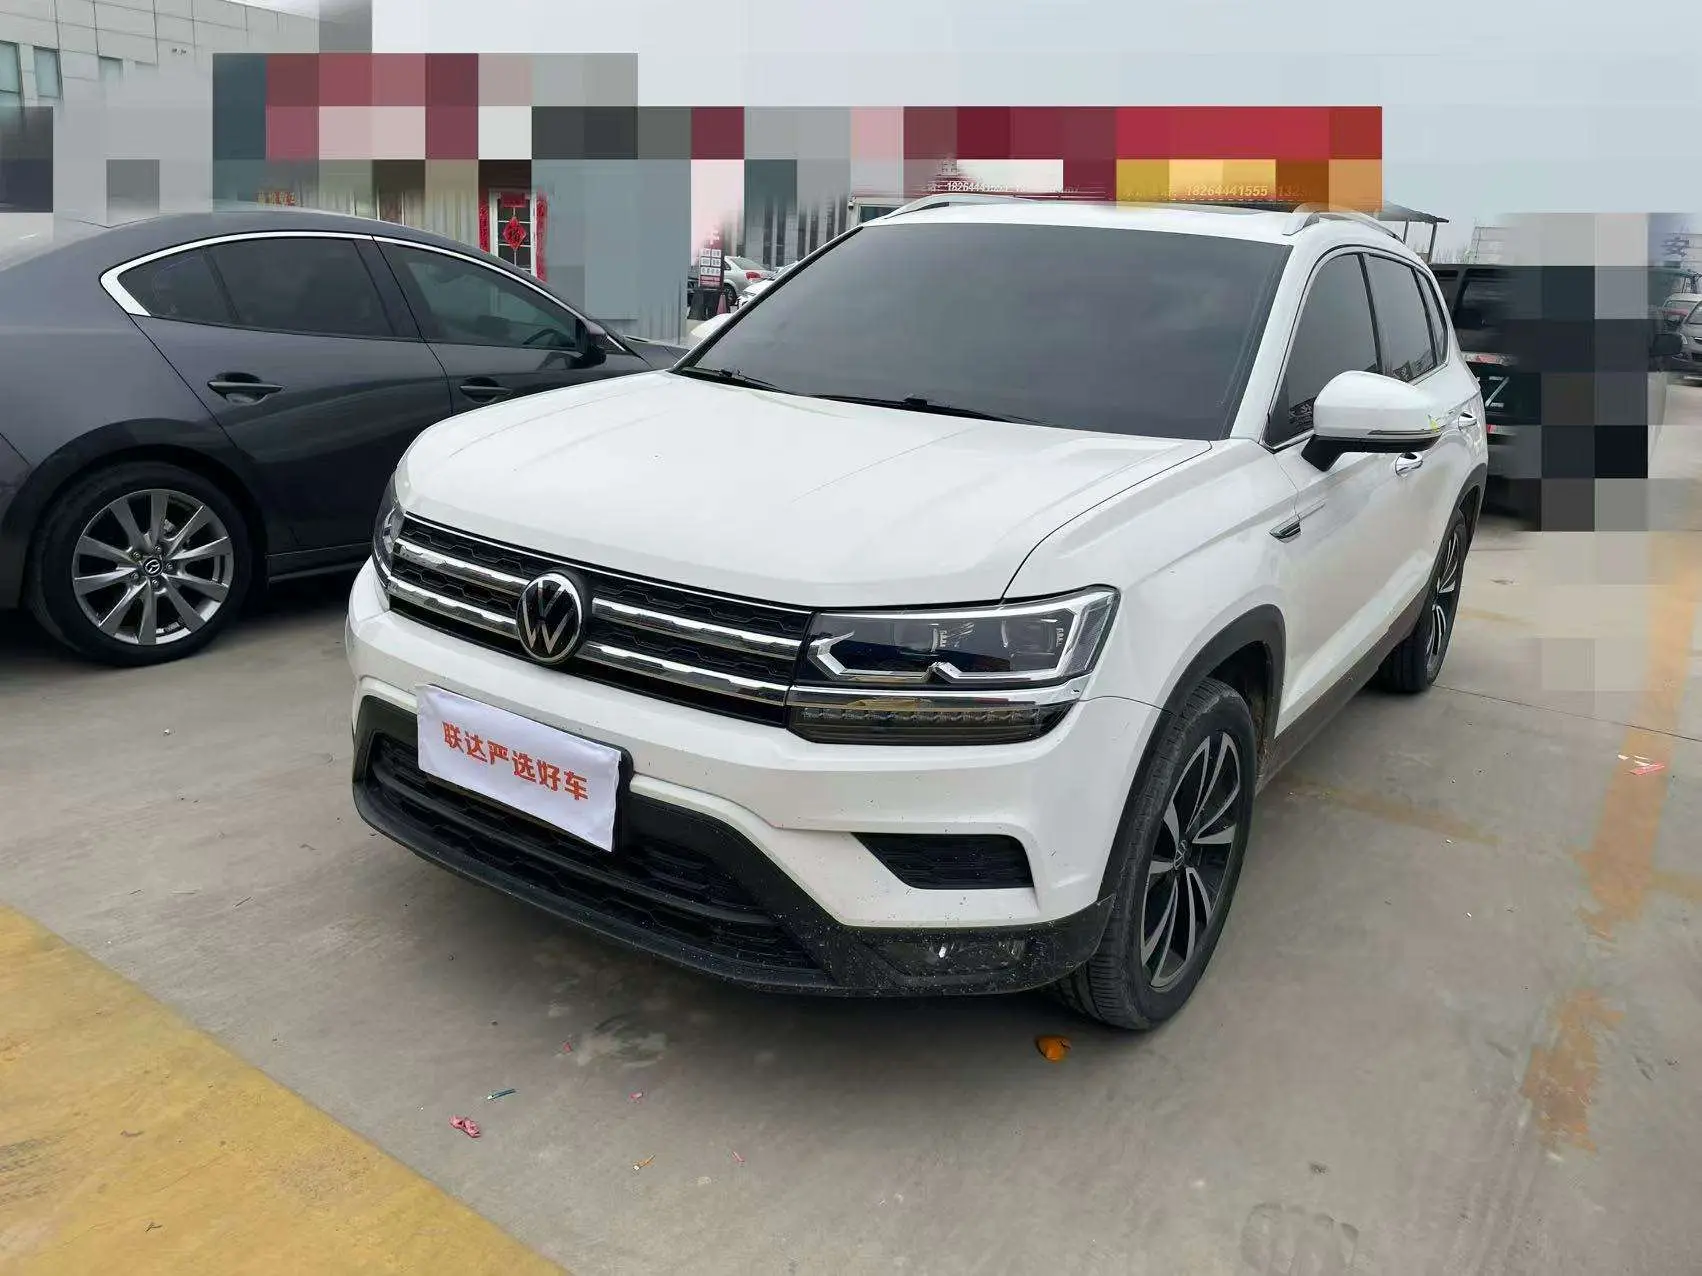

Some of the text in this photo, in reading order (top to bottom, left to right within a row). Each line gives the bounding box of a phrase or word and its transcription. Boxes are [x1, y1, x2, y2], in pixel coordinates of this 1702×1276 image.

[442, 721, 589, 801] 联达严选好车
